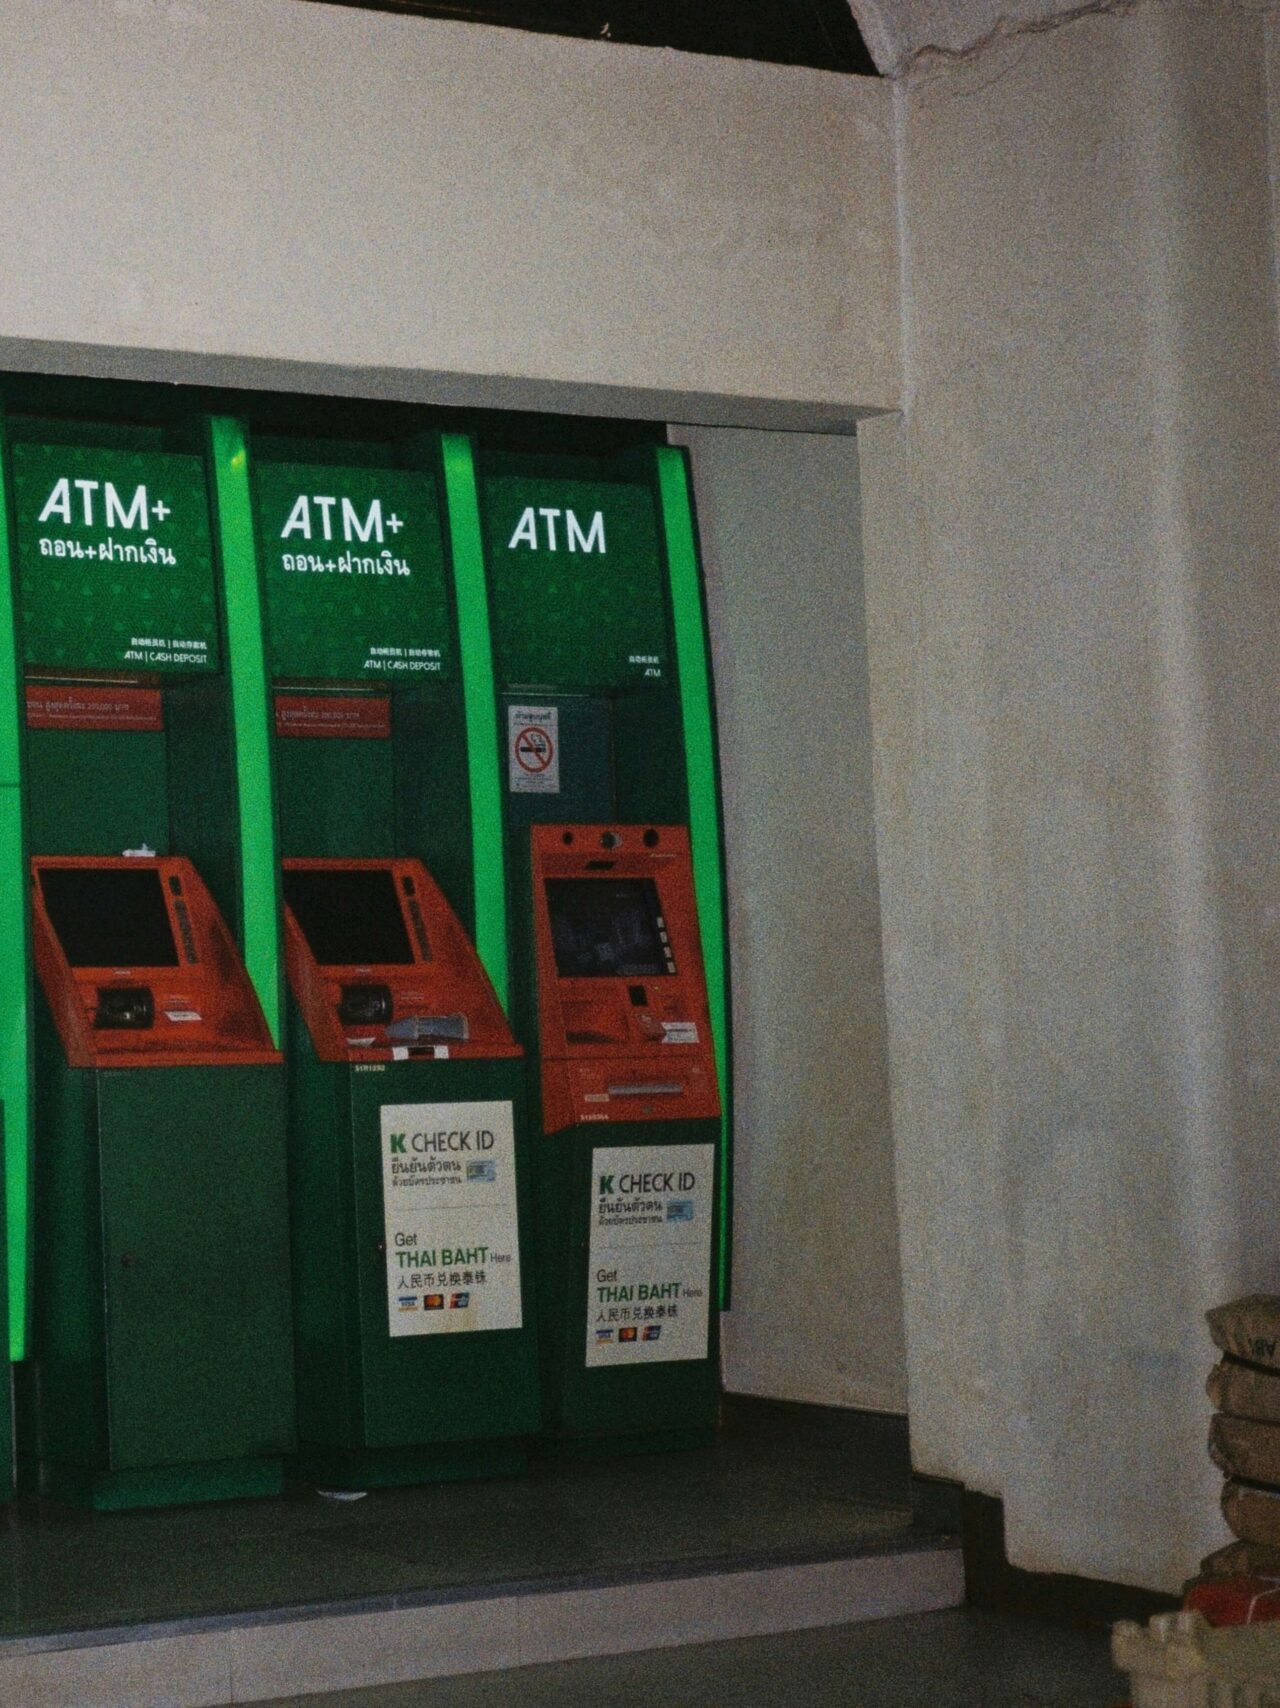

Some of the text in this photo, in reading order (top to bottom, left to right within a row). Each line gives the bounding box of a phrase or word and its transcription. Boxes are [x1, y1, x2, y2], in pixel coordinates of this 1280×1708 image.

[38, 477, 171, 531] ATM+
[280, 495, 404, 543] ATM+
[508, 506, 607, 554] ATM
[38, 537, 177, 566] ถอน+ฝากเงิน
[282, 549, 411, 577] ถอน+ฝากเงิน
[124, 650, 208, 664] ATM CASH DEPOSIT
[387, 661, 408, 670] CASH
[409, 662, 441, 671] DEPOSIT
[390, 1130, 494, 1153] K CHECK ID
[600, 1172, 695, 1194] K CHECK ID
[394, 1232, 417, 1247] Get
[395, 1249, 436, 1268] THAI
[441, 1247, 488, 1266] BAHT
[596, 1269, 618, 1283] Get
[597, 1285, 634, 1302] THAI
[638, 1282, 682, 1300] BAHT
